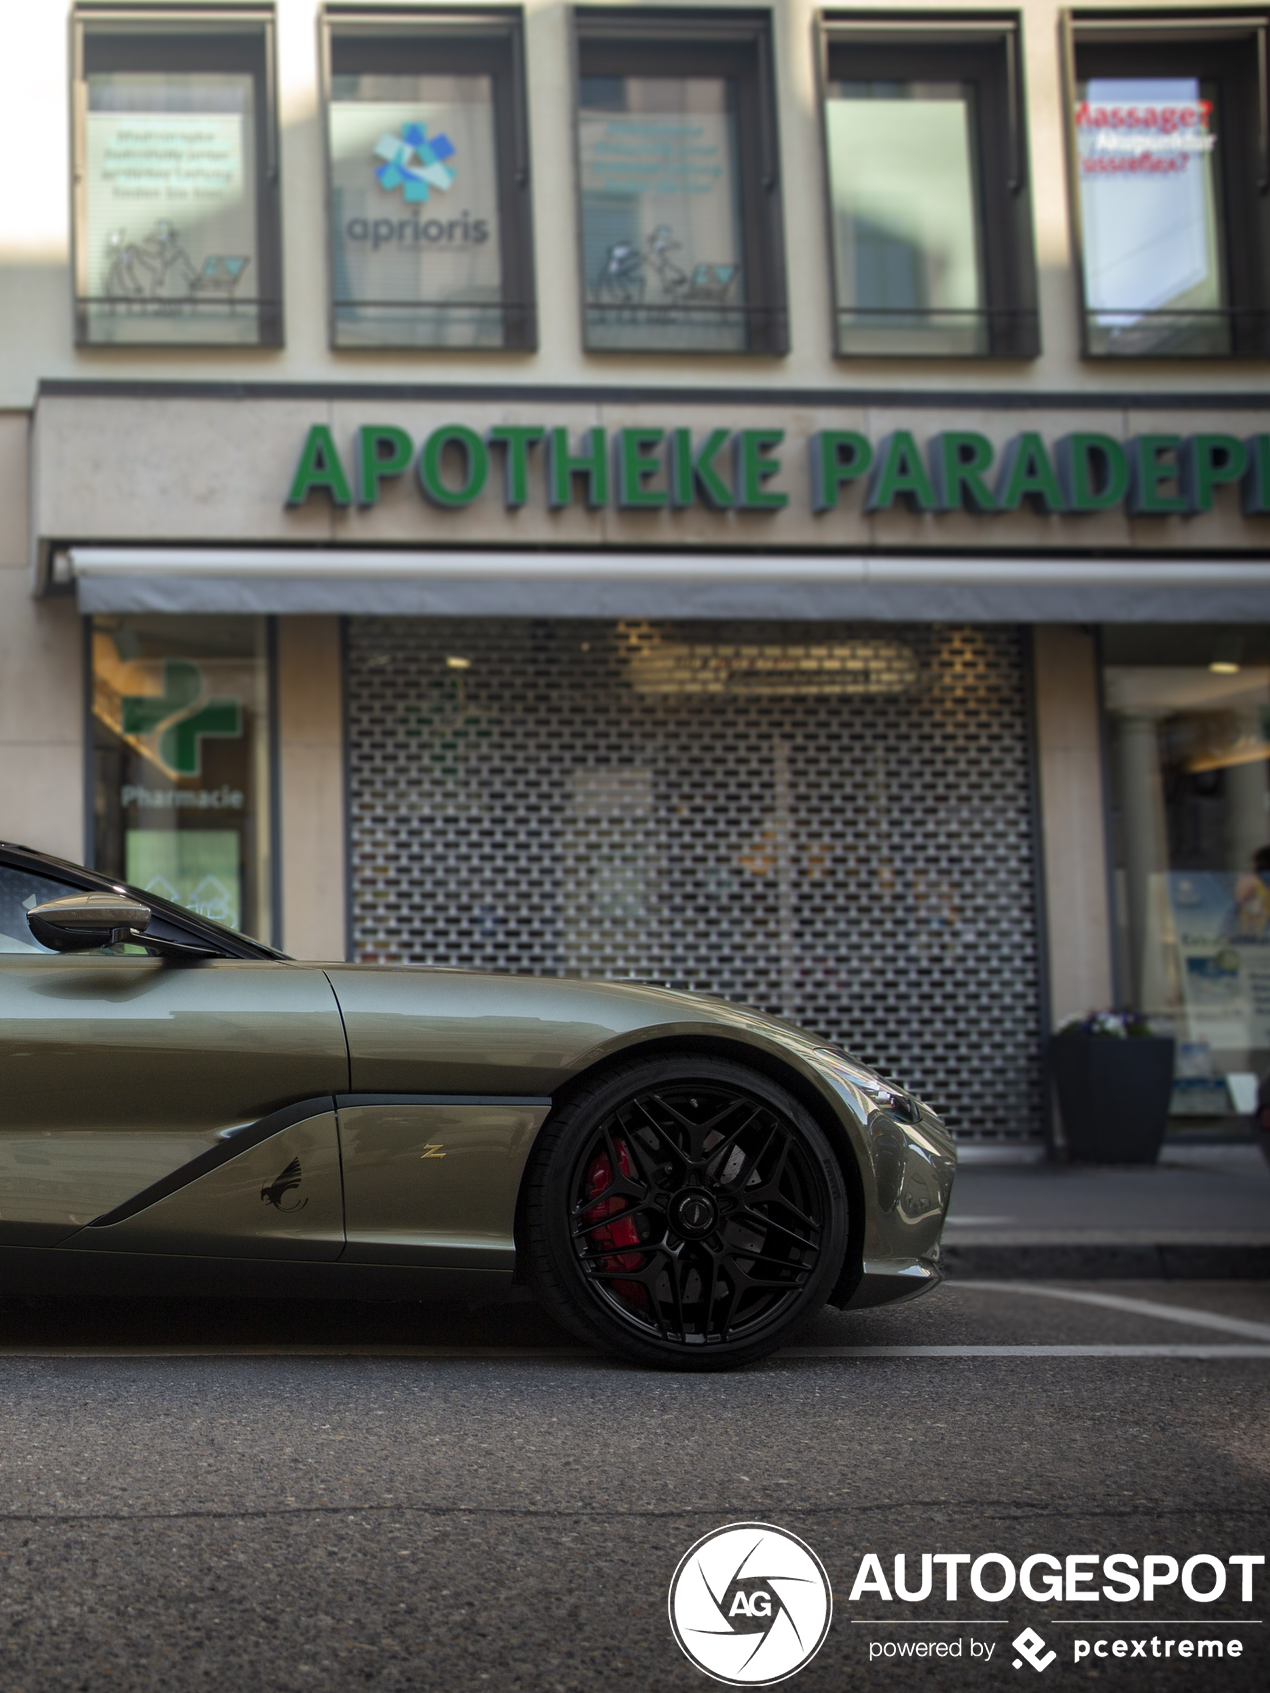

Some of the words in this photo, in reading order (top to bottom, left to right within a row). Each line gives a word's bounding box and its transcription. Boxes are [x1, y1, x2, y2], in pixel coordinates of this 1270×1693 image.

[347, 209, 489, 251] aprioris
[284, 424, 789, 509] APOTHEKE
[120, 785, 245, 809] Pharmacie
